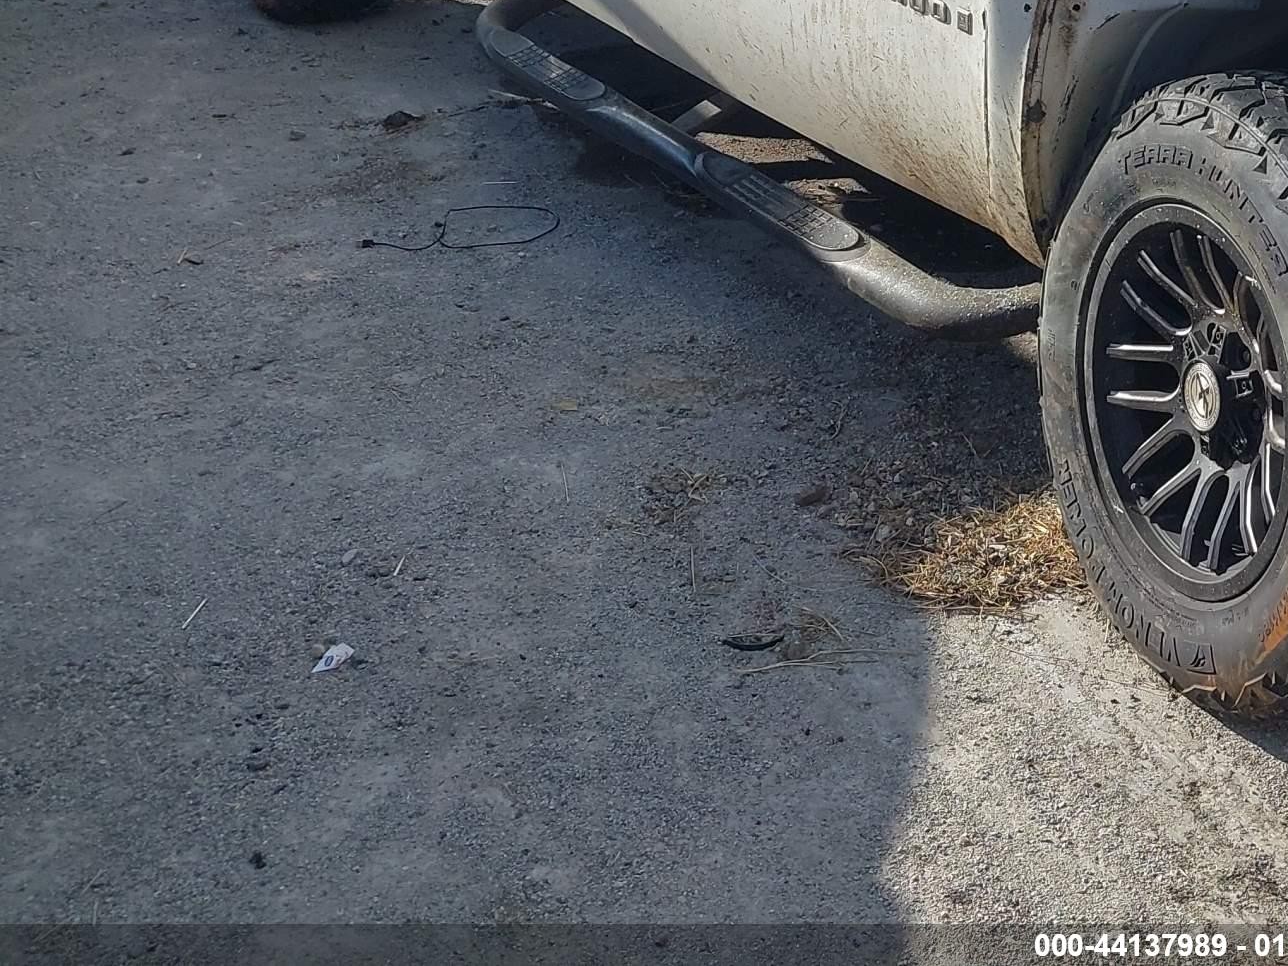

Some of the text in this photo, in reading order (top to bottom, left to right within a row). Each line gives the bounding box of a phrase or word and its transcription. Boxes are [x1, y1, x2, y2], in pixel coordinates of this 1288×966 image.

[1117, 144, 1194, 175] TERRA
[1056, 458, 1182, 668] VENOM POWER
